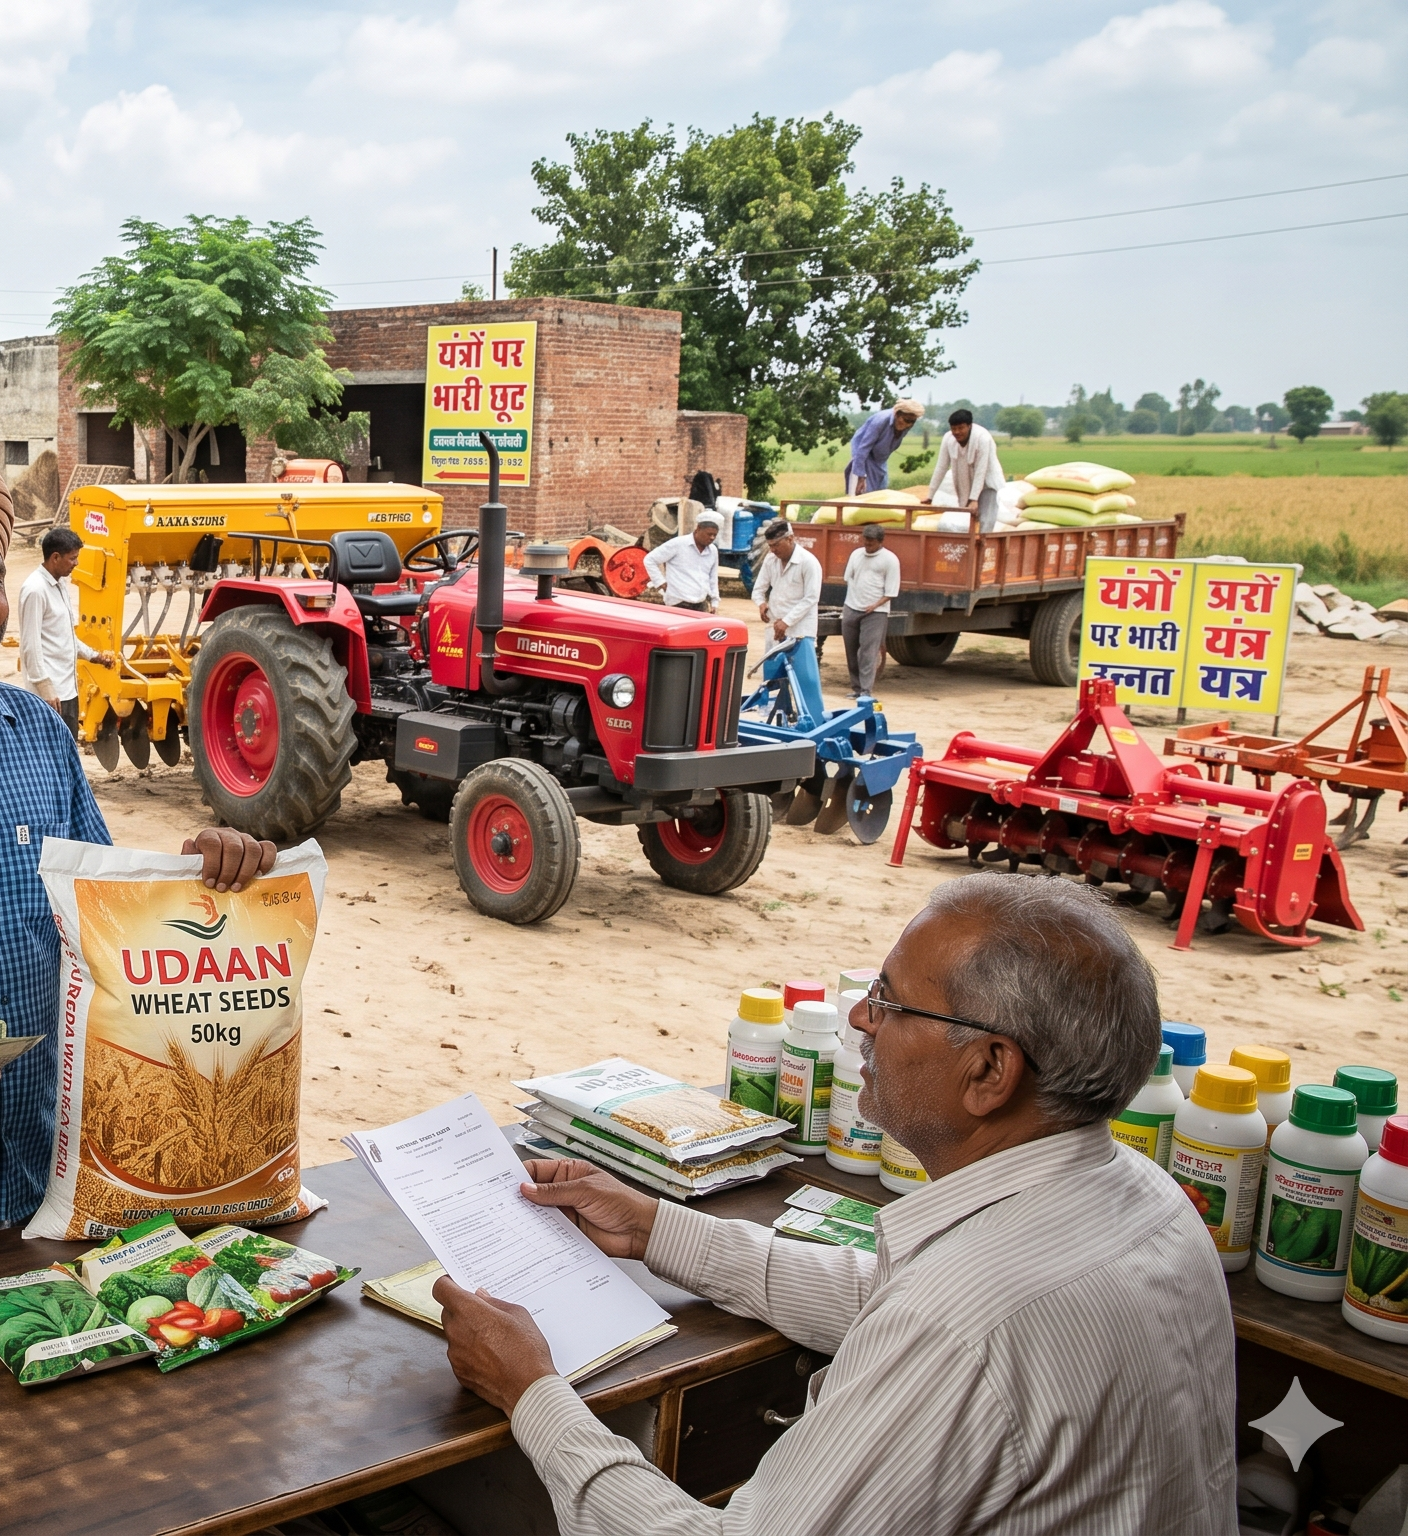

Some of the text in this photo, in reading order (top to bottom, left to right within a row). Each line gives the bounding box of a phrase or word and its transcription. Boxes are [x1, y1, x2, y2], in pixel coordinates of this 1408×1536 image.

[438, 331, 525, 369] यंत्रों पर
[433, 376, 527, 423] भारी छूट
[1099, 568, 1182, 612] यंत्रों
[516, 636, 580, 660] Mahindra
[1091, 622, 1180, 651] पर भारी
[1203, 618, 1272, 661] यंत्र
[1199, 665, 1268, 701] यत्र
[121, 945, 293, 986] UDAAN
[131, 986, 291, 1016] WHEAT SEEDS
[190, 1023, 242, 1047] 50kg
